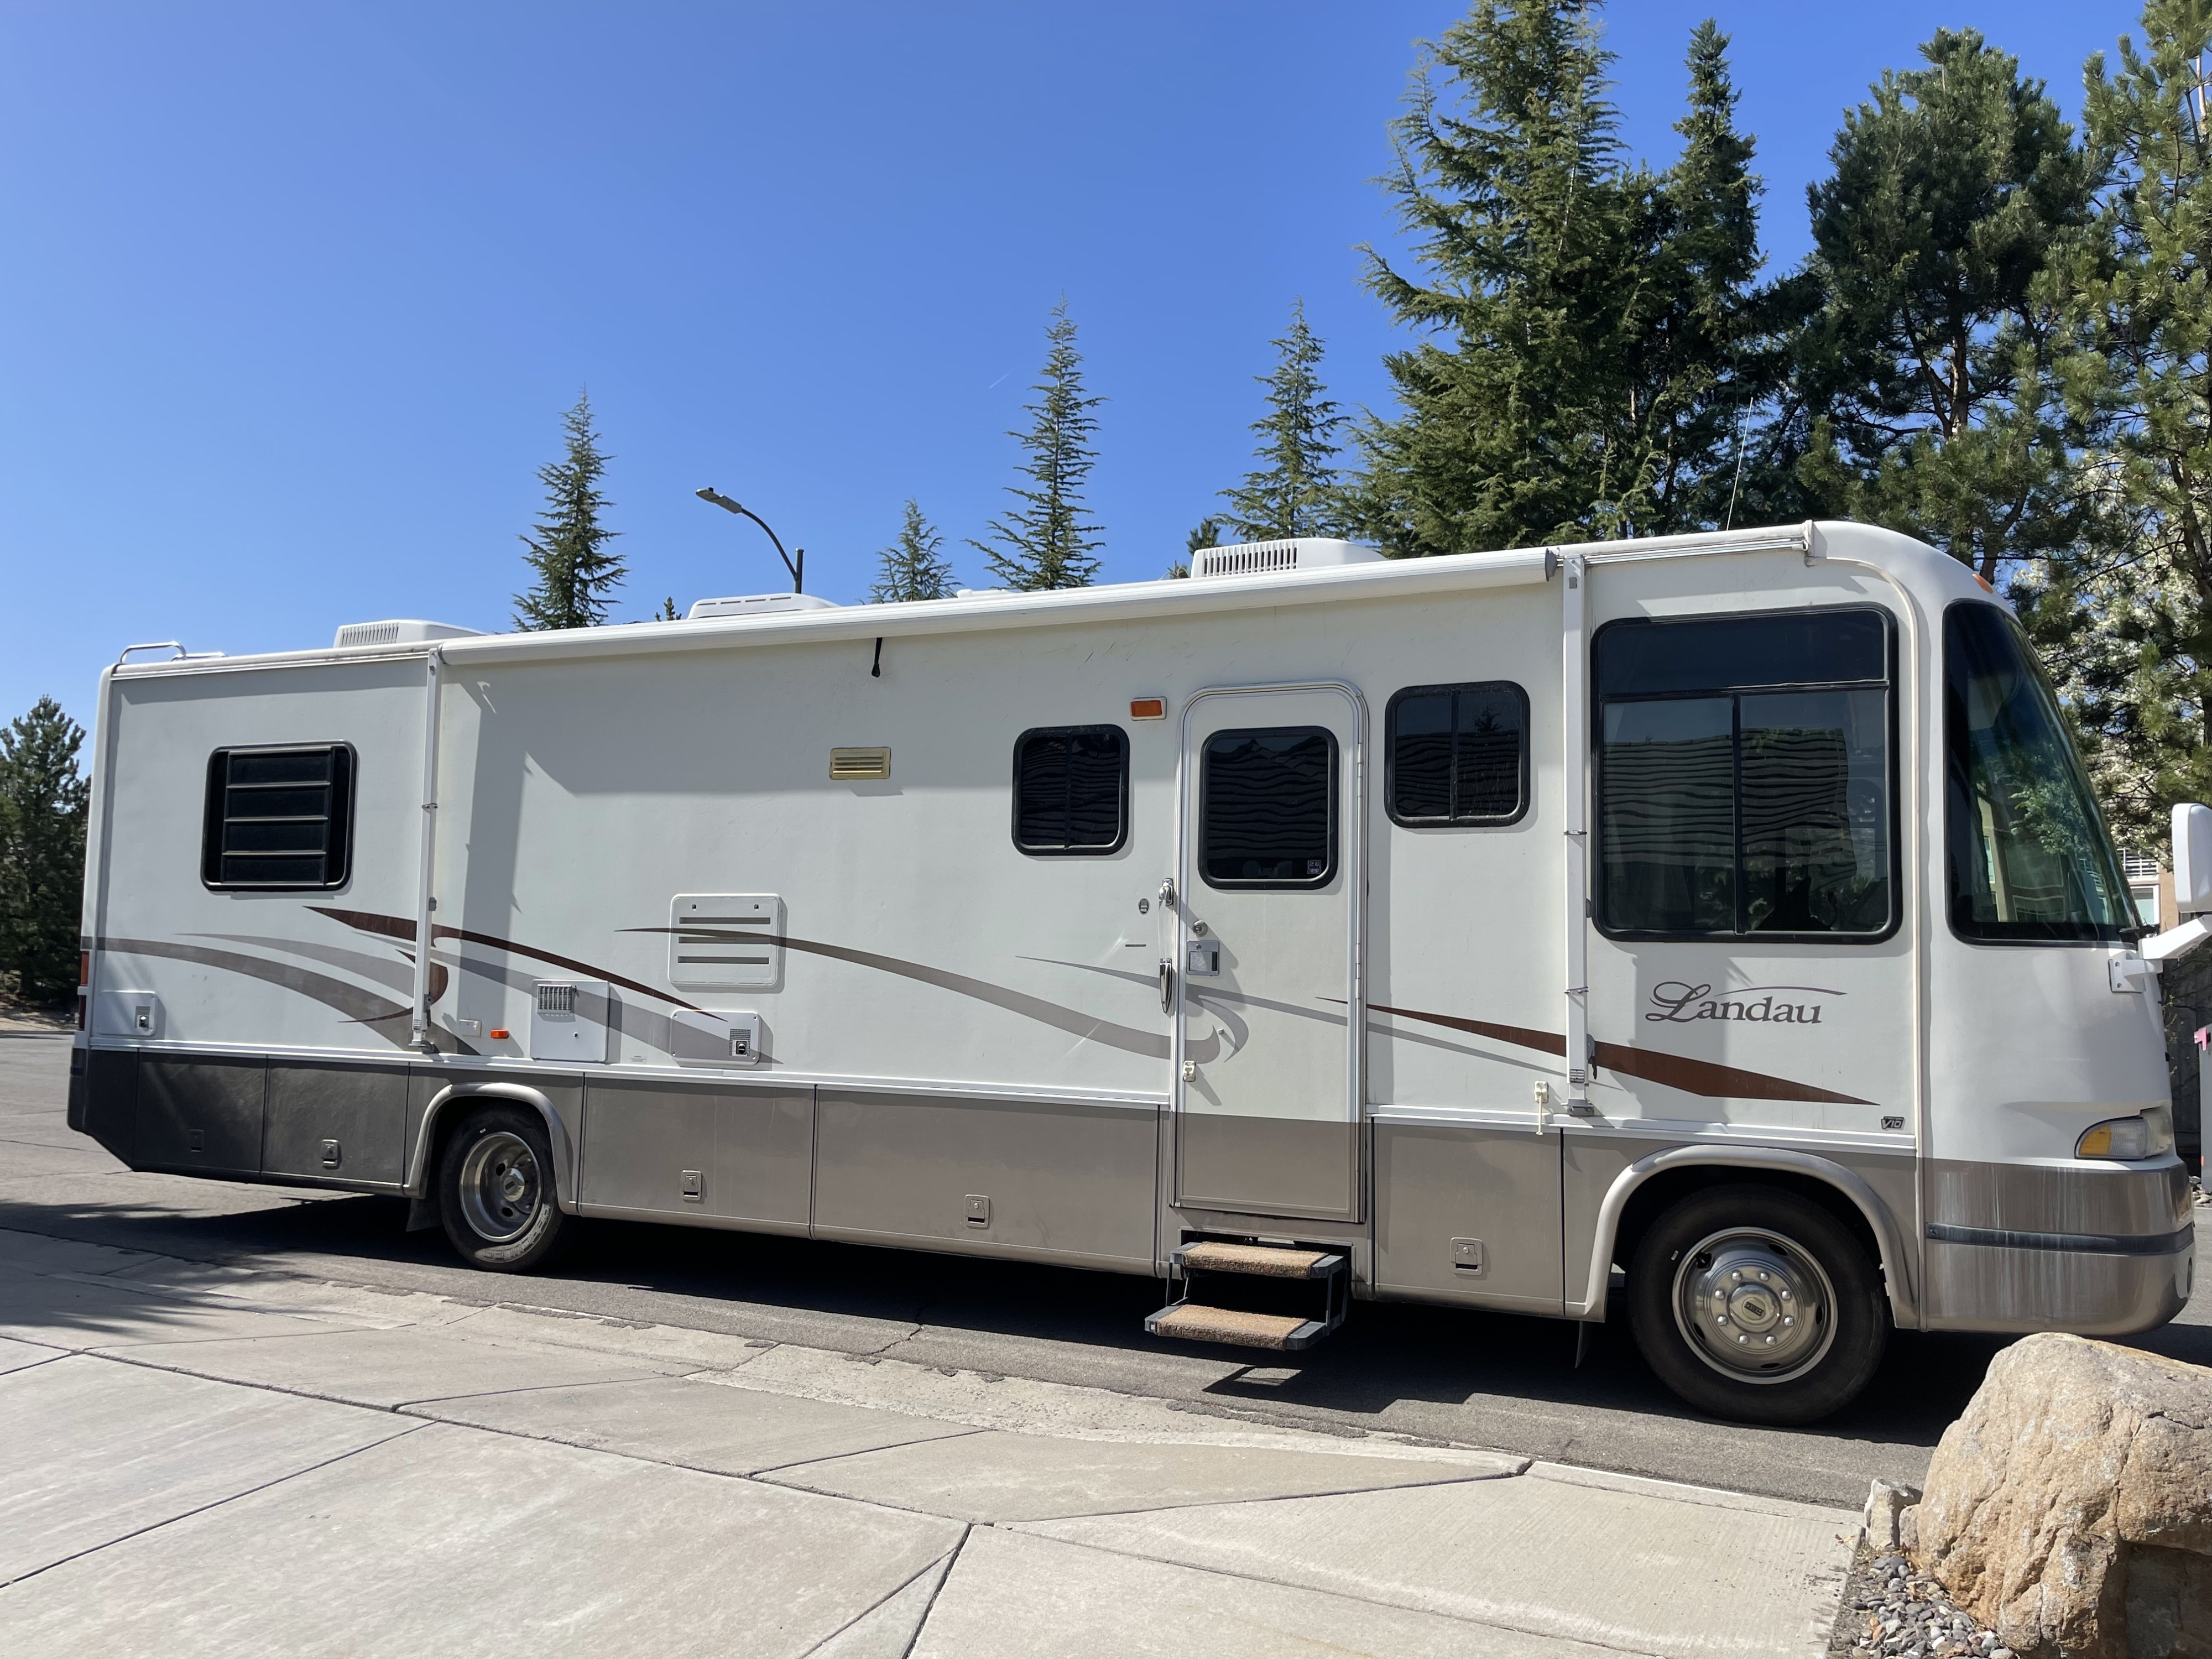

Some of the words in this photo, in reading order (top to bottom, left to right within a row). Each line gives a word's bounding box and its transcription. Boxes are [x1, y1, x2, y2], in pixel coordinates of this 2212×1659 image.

[1645, 982, 1821, 1024] Landau
[1881, 1119, 1902, 1129] V10
[483, 1204, 551, 1260] HERCULES
